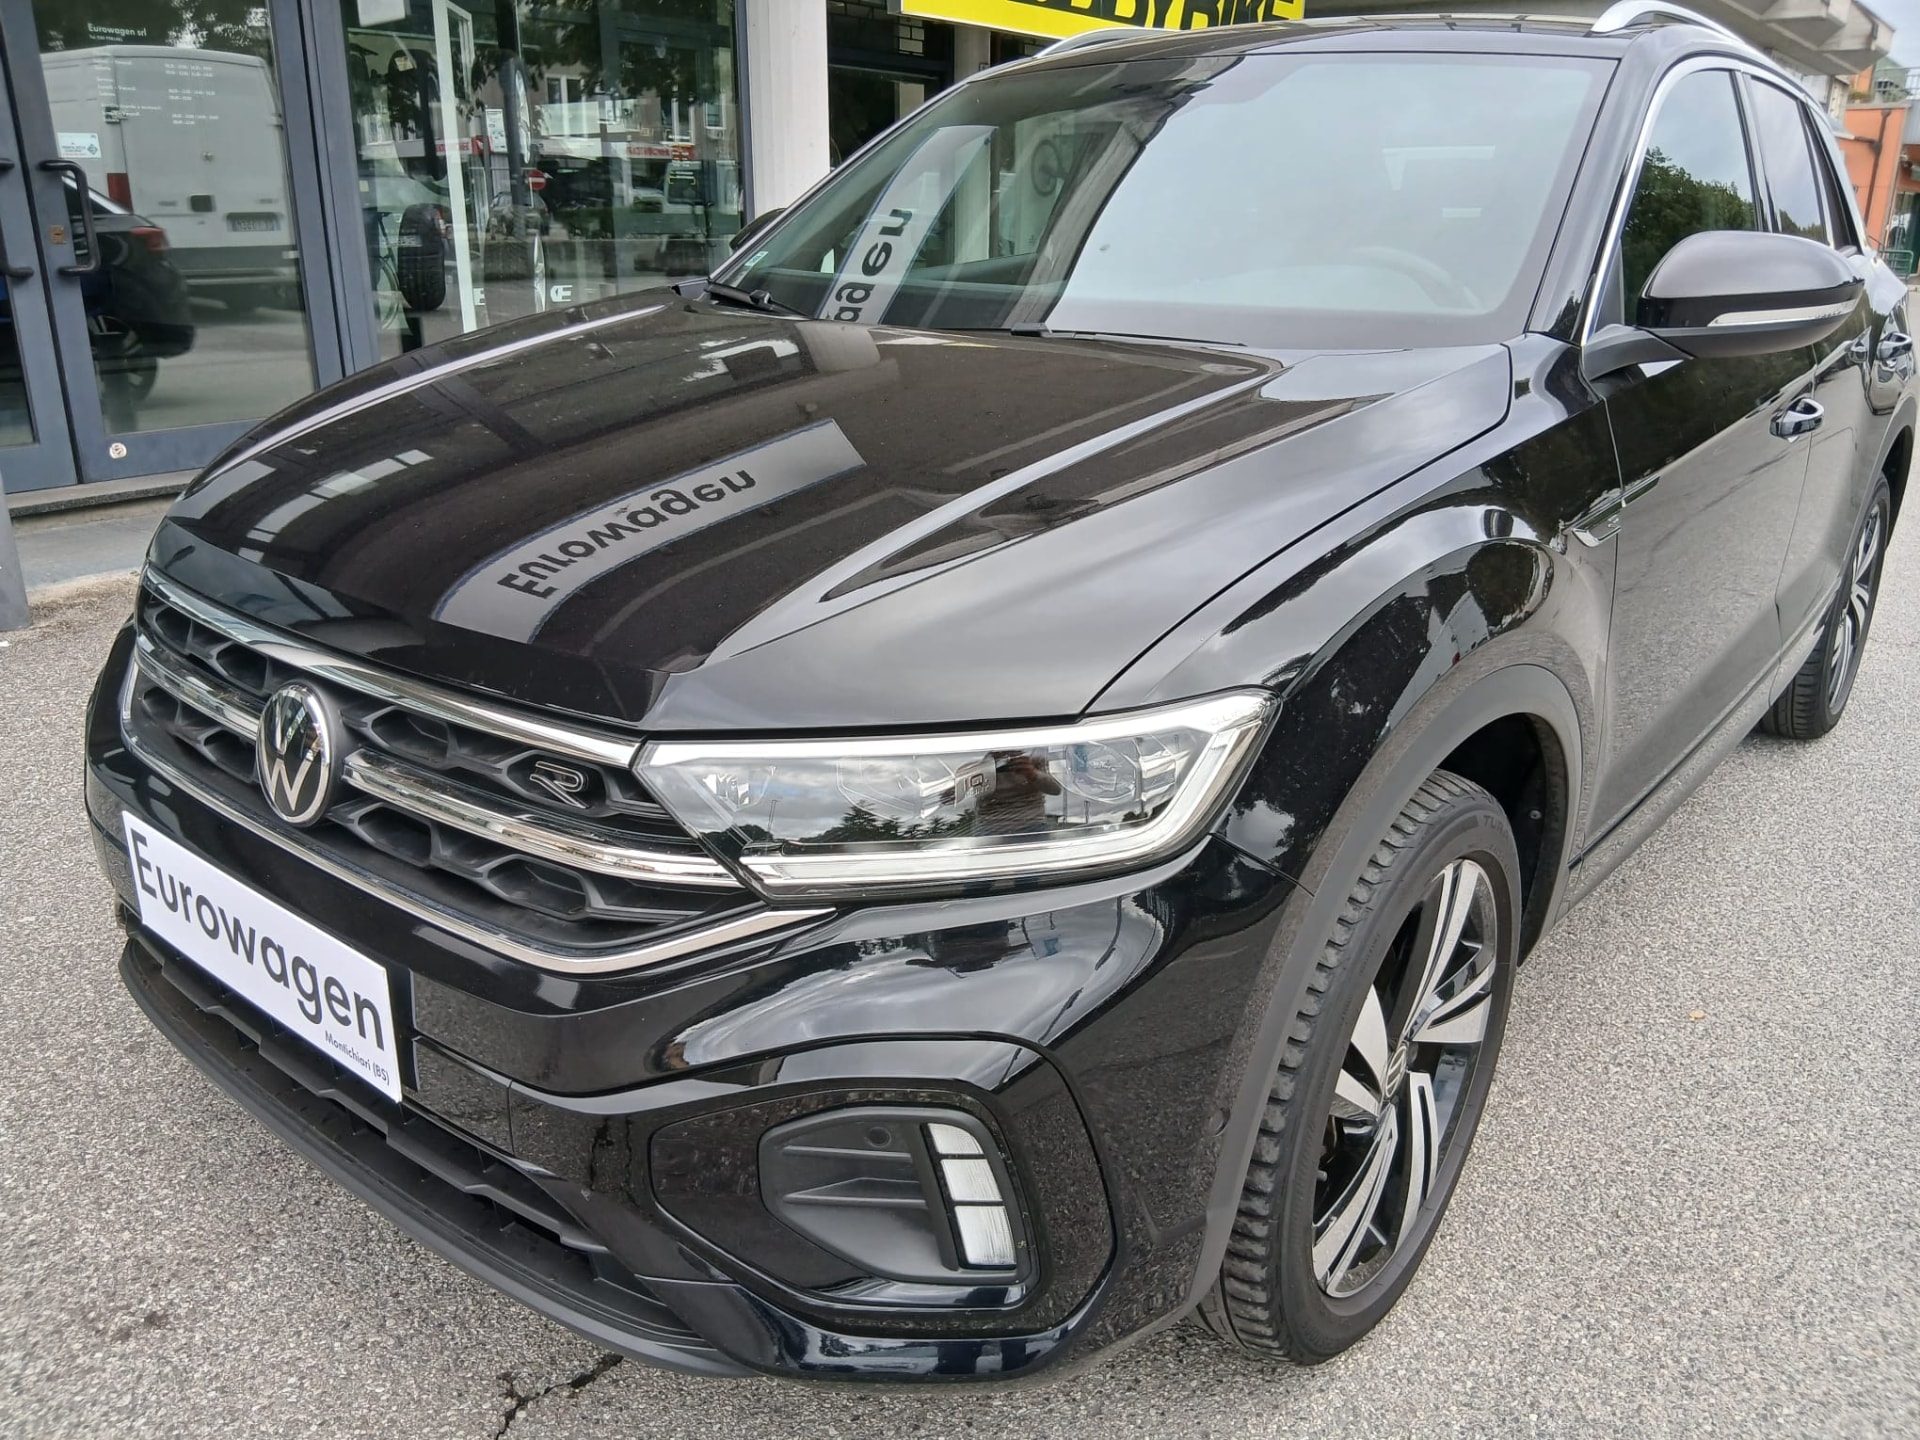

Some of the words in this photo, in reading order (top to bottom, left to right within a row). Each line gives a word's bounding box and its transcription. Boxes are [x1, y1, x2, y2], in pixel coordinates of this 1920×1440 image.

[87, 23, 136, 37] Eurowagen
[131, 828, 385, 1051] Eurowagen
[325, 1030, 371, 1071] Montichiari
[372, 1062, 390, 1086] (BS)
